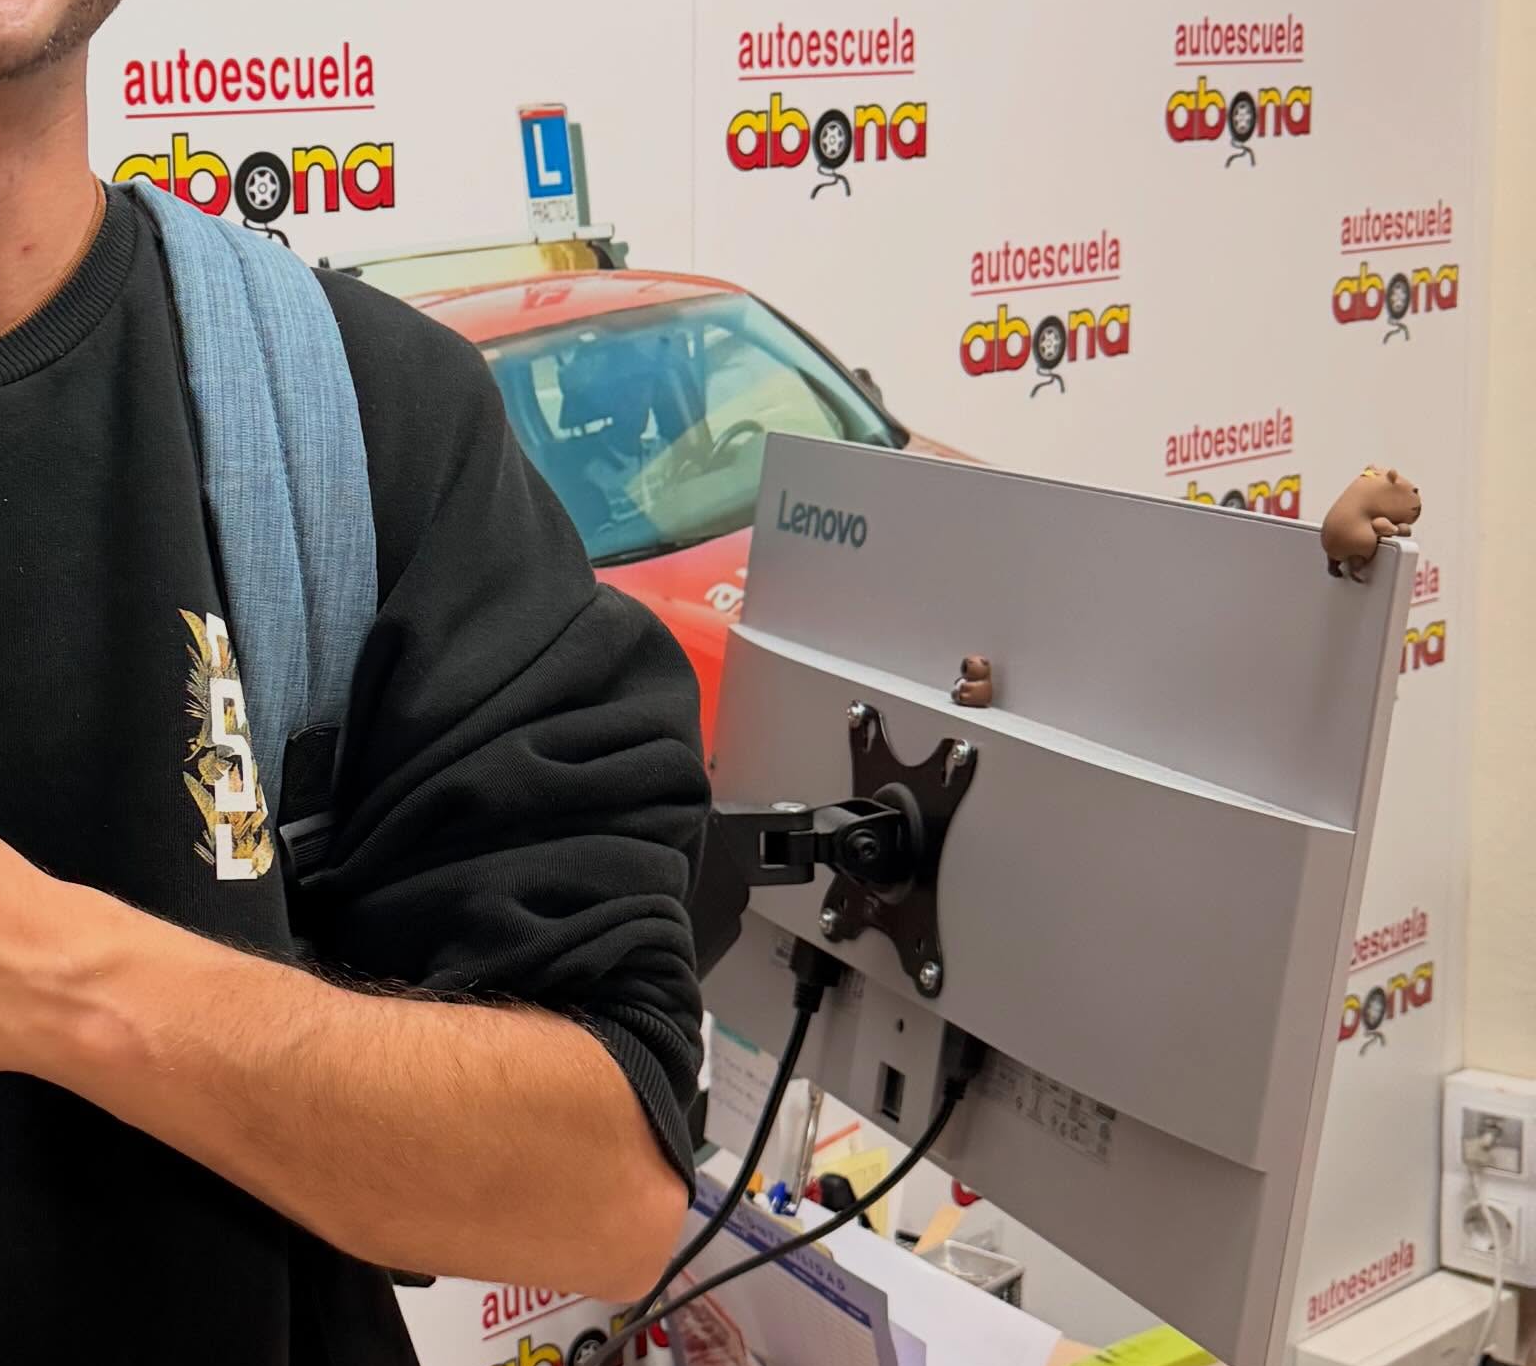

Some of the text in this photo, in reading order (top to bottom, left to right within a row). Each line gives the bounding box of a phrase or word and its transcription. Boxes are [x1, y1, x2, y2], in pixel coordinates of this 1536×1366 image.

[738, 17, 916, 71] autoescuela
[1174, 13, 1305, 57] autoescuela
[124, 42, 376, 106] autoescuela
[726, 92, 928, 171] abona
[1165, 76, 1312, 143] abona
[532, 122, 563, 187] L
[1341, 199, 1453, 247] autoescuela
[971, 229, 1121, 287] autoescuela
[1332, 261, 1460, 325] abona
[960, 303, 1131, 376] abona
[1166, 407, 1293, 467] autoescuela
[777, 489, 868, 549] Lenovo
[1350, 907, 1428, 966] escuela
[1337, 960, 1434, 1043] bona
[1307, 1238, 1416, 1323] autoescuela
